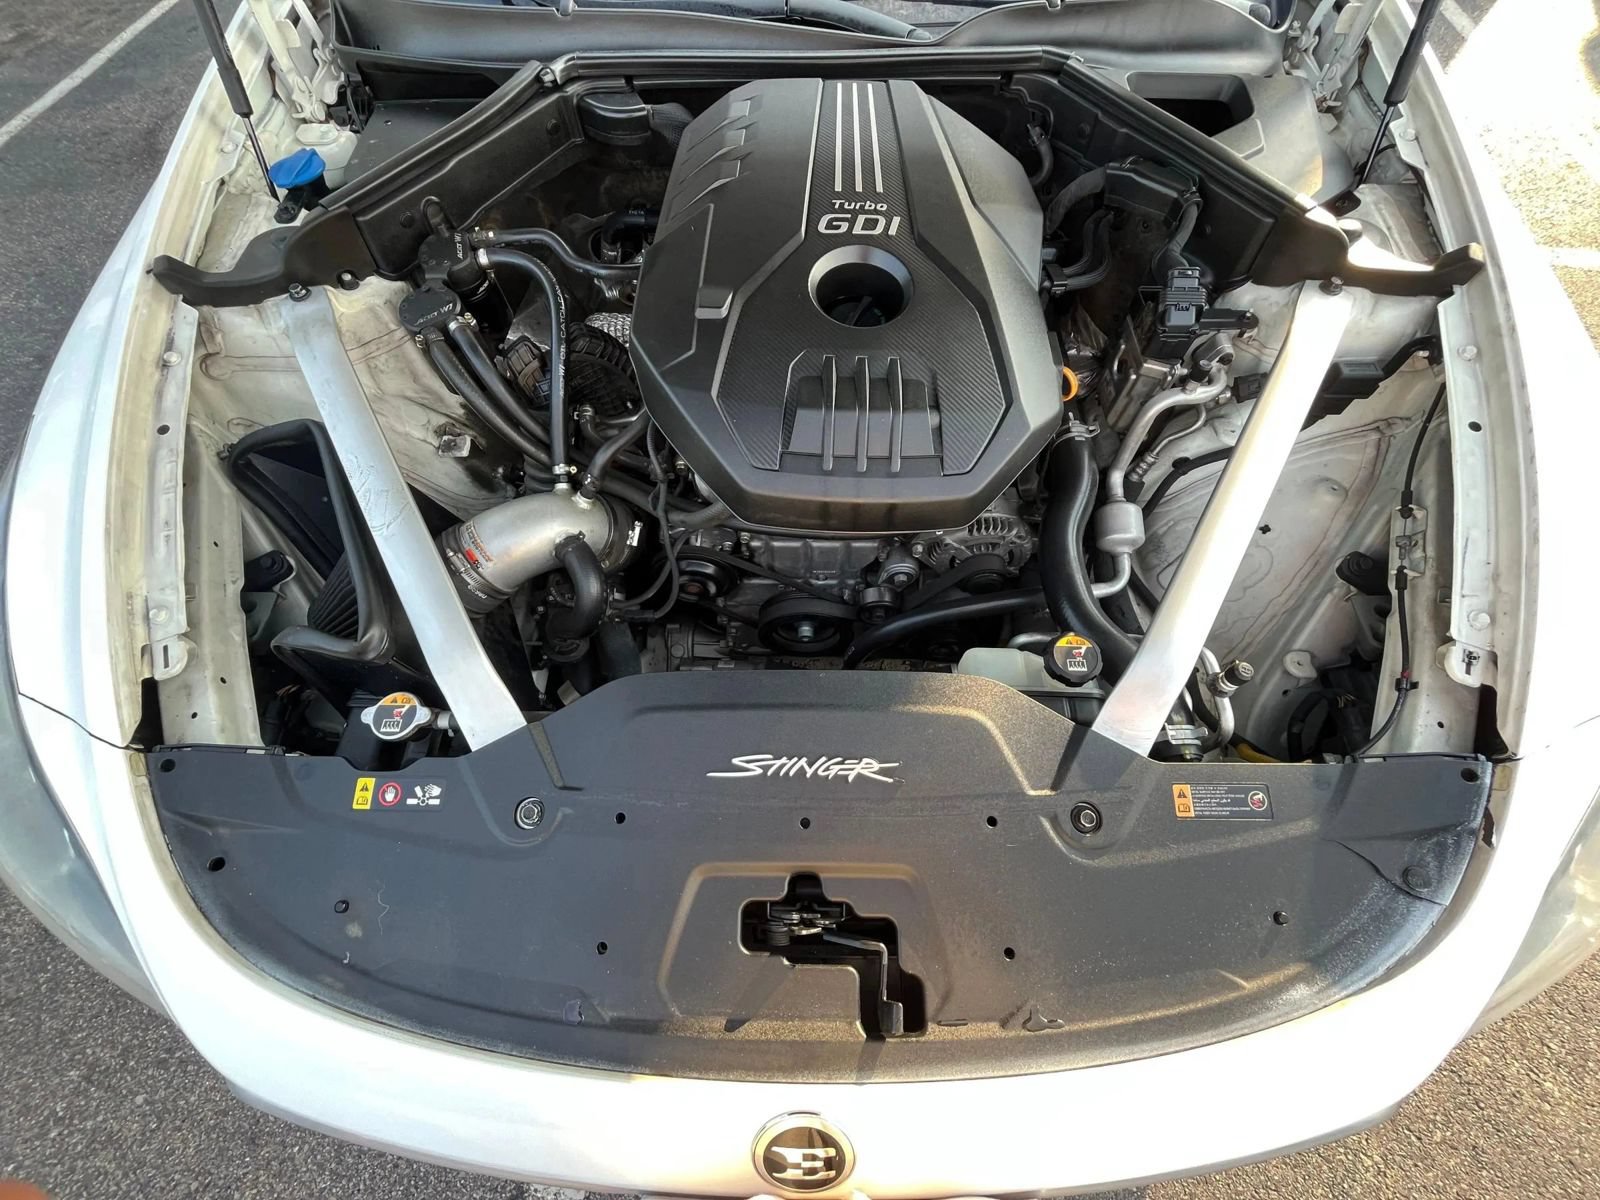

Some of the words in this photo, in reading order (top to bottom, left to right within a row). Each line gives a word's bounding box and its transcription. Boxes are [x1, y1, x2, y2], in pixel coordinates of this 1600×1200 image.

[831, 199, 888, 211] Turbo
[817, 213, 901, 236] GDI
[706, 754, 900, 783] STINGER
